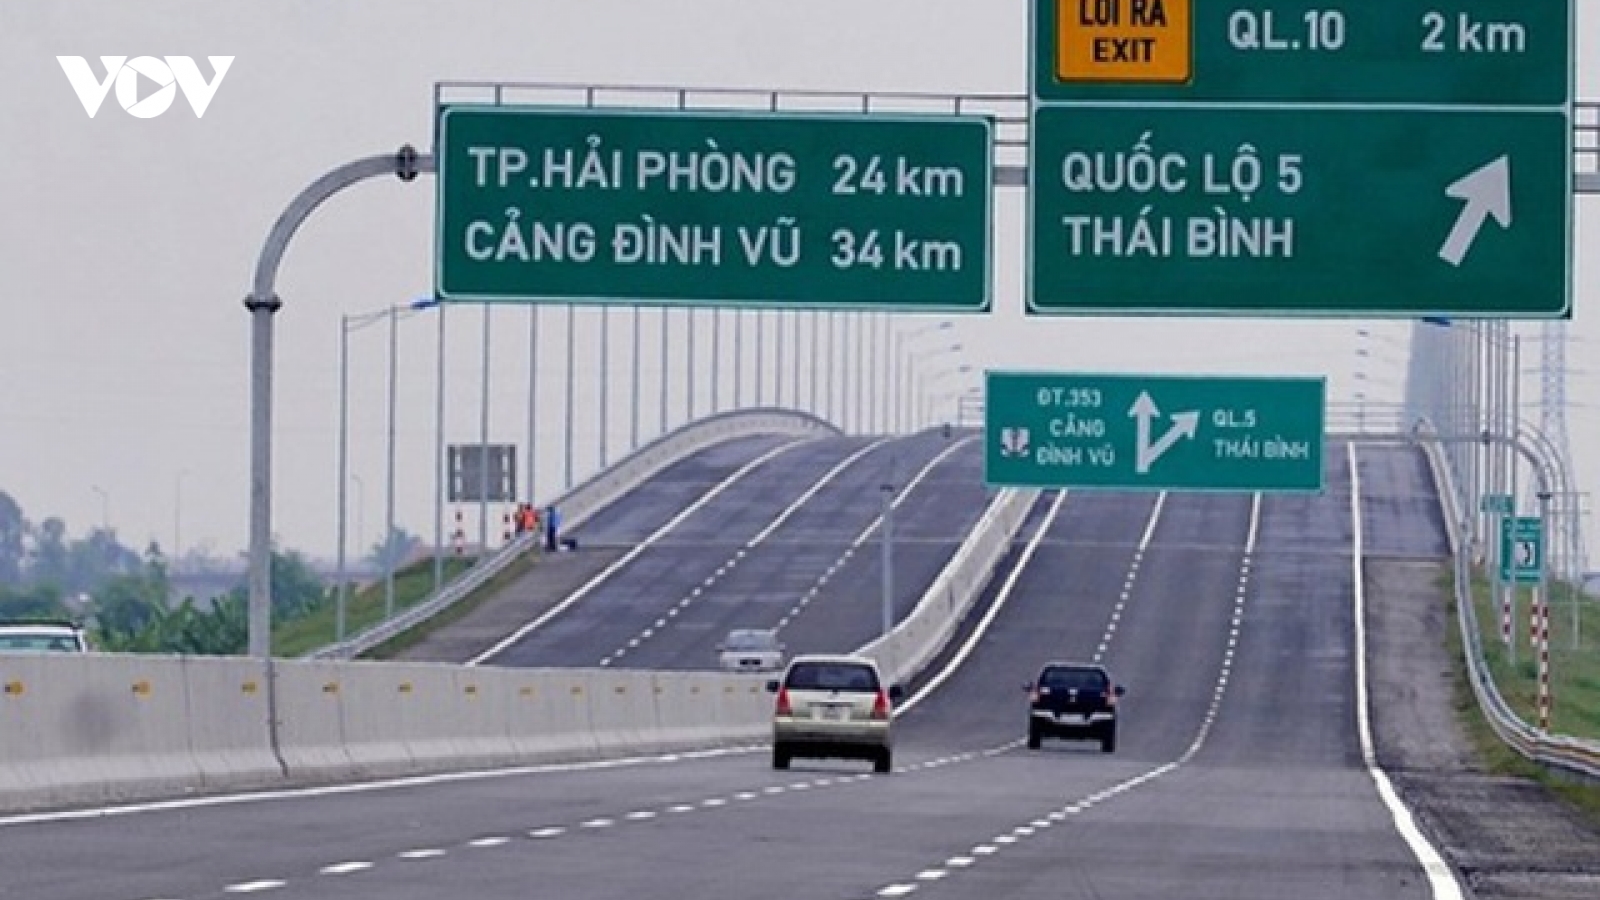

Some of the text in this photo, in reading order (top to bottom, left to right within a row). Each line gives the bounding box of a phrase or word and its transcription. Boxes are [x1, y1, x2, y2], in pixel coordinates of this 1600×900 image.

[1130, 0, 1168, 27] RA
[1228, 10, 1526, 52] QL.10 2 km
[1093, 37, 1156, 62] EXIT
[468, 134, 964, 196] TP.HẢI PHÒNG 24 km
[1063, 131, 1302, 203] QUỐC LỘ 5
[465, 207, 962, 271] CẢNG ĐÌNH VŨ 34 km
[1063, 206, 1294, 257] THÁI BÌNH
[1213, 409, 1256, 428] QL.5
[1213, 434, 1310, 460] THÁI BÌNH
